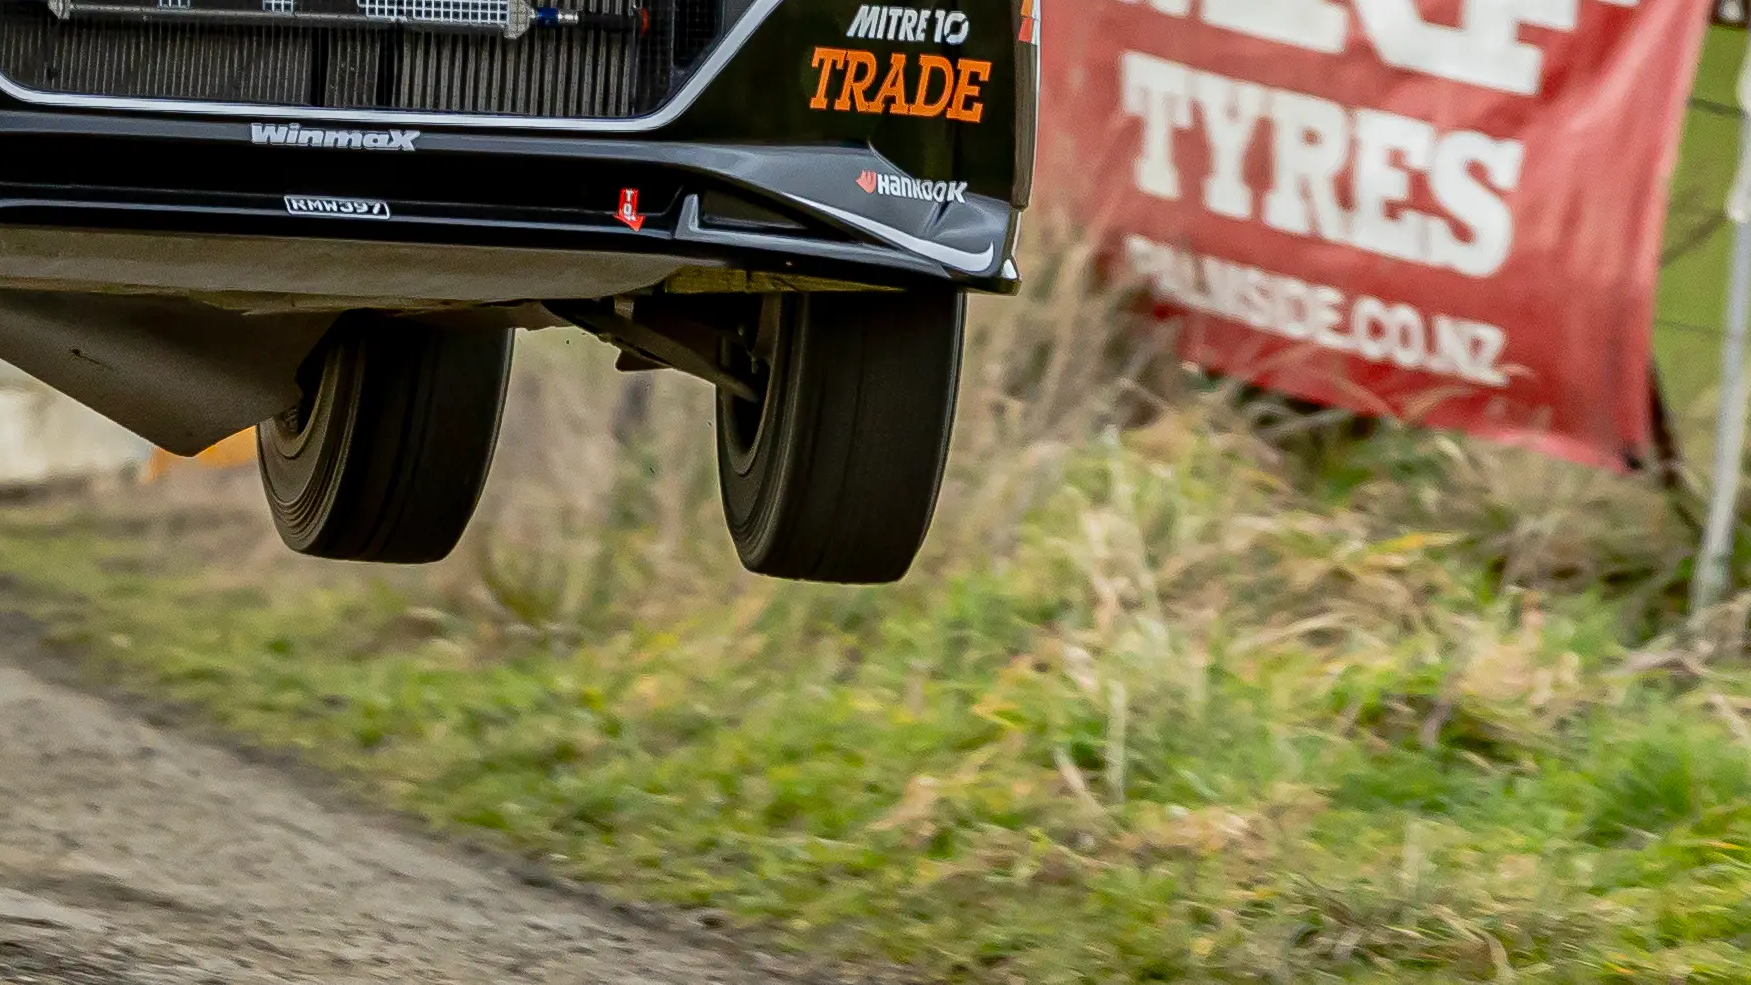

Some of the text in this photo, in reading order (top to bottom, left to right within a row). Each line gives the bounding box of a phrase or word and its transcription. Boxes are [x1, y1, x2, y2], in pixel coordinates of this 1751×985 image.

[846, 4, 970, 45] MITRE 10
[808, 46, 993, 123] TRADE
[1119, 49, 1525, 279] TYRES
